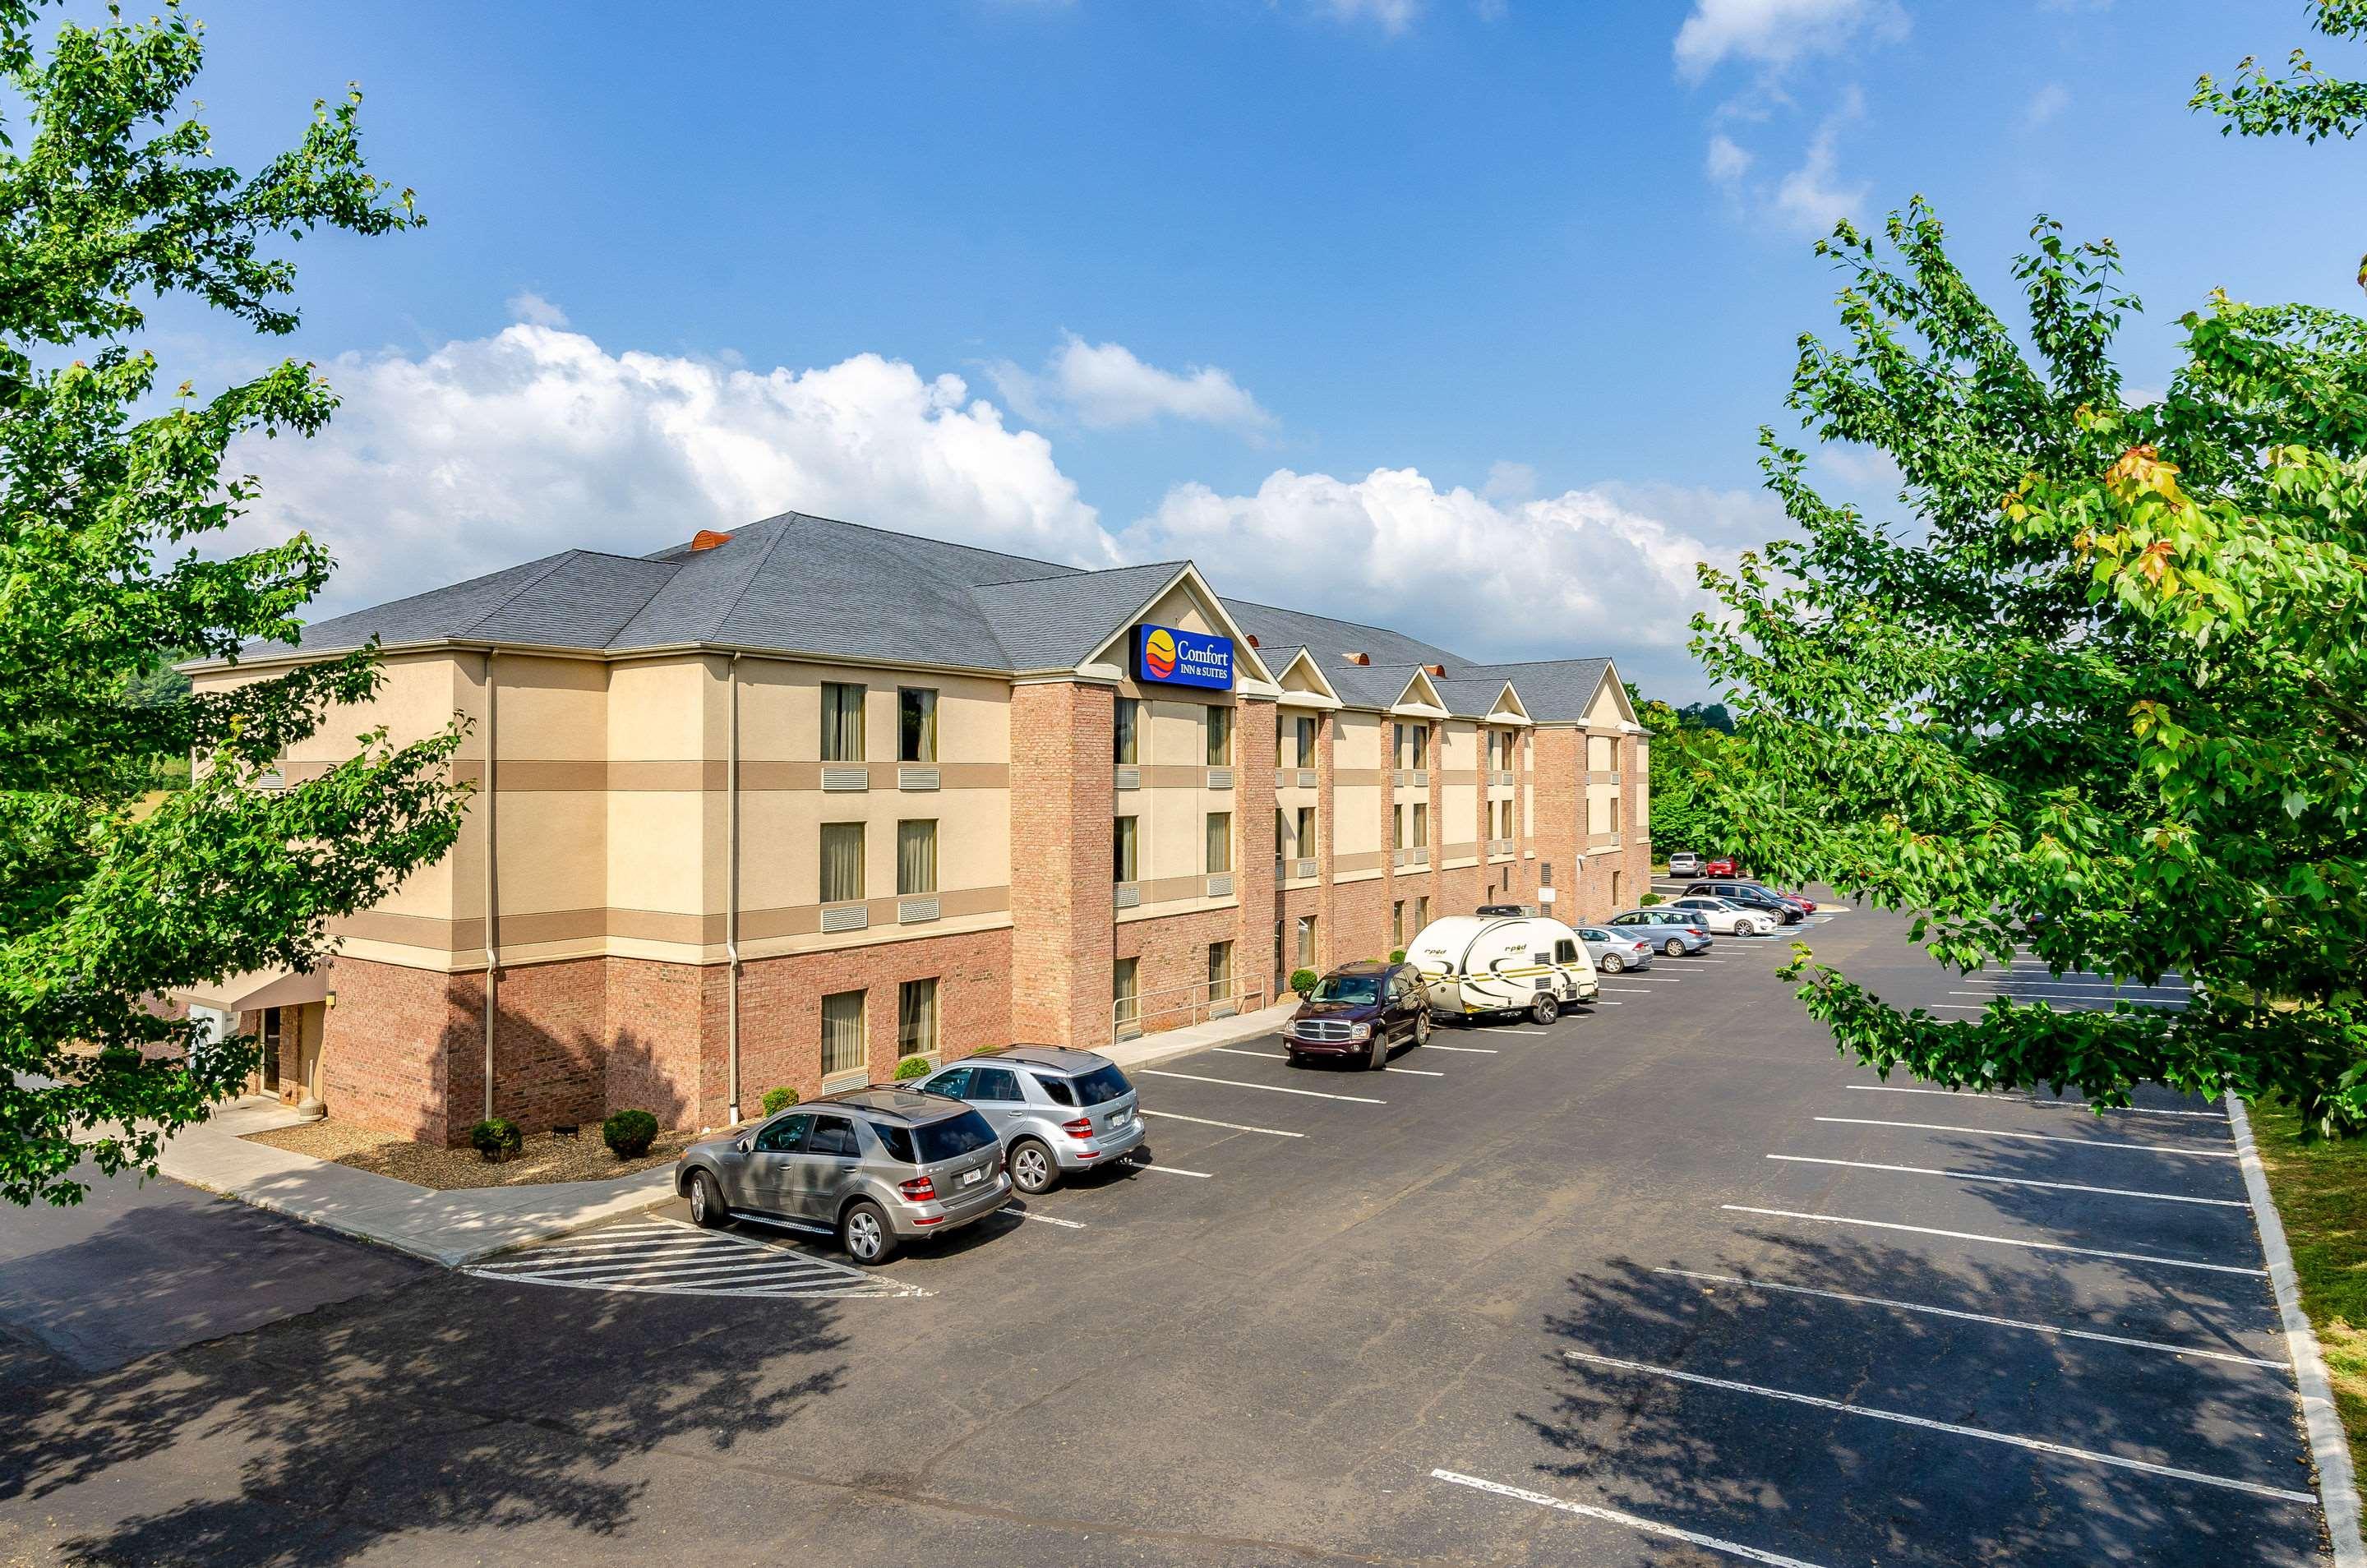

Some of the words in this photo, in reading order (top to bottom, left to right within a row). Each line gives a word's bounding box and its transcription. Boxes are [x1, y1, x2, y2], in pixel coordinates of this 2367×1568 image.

[1178, 640, 1228, 666] Comfort
[1181, 664, 1195, 674] INN
[1202, 667, 1227, 679] SUITES
